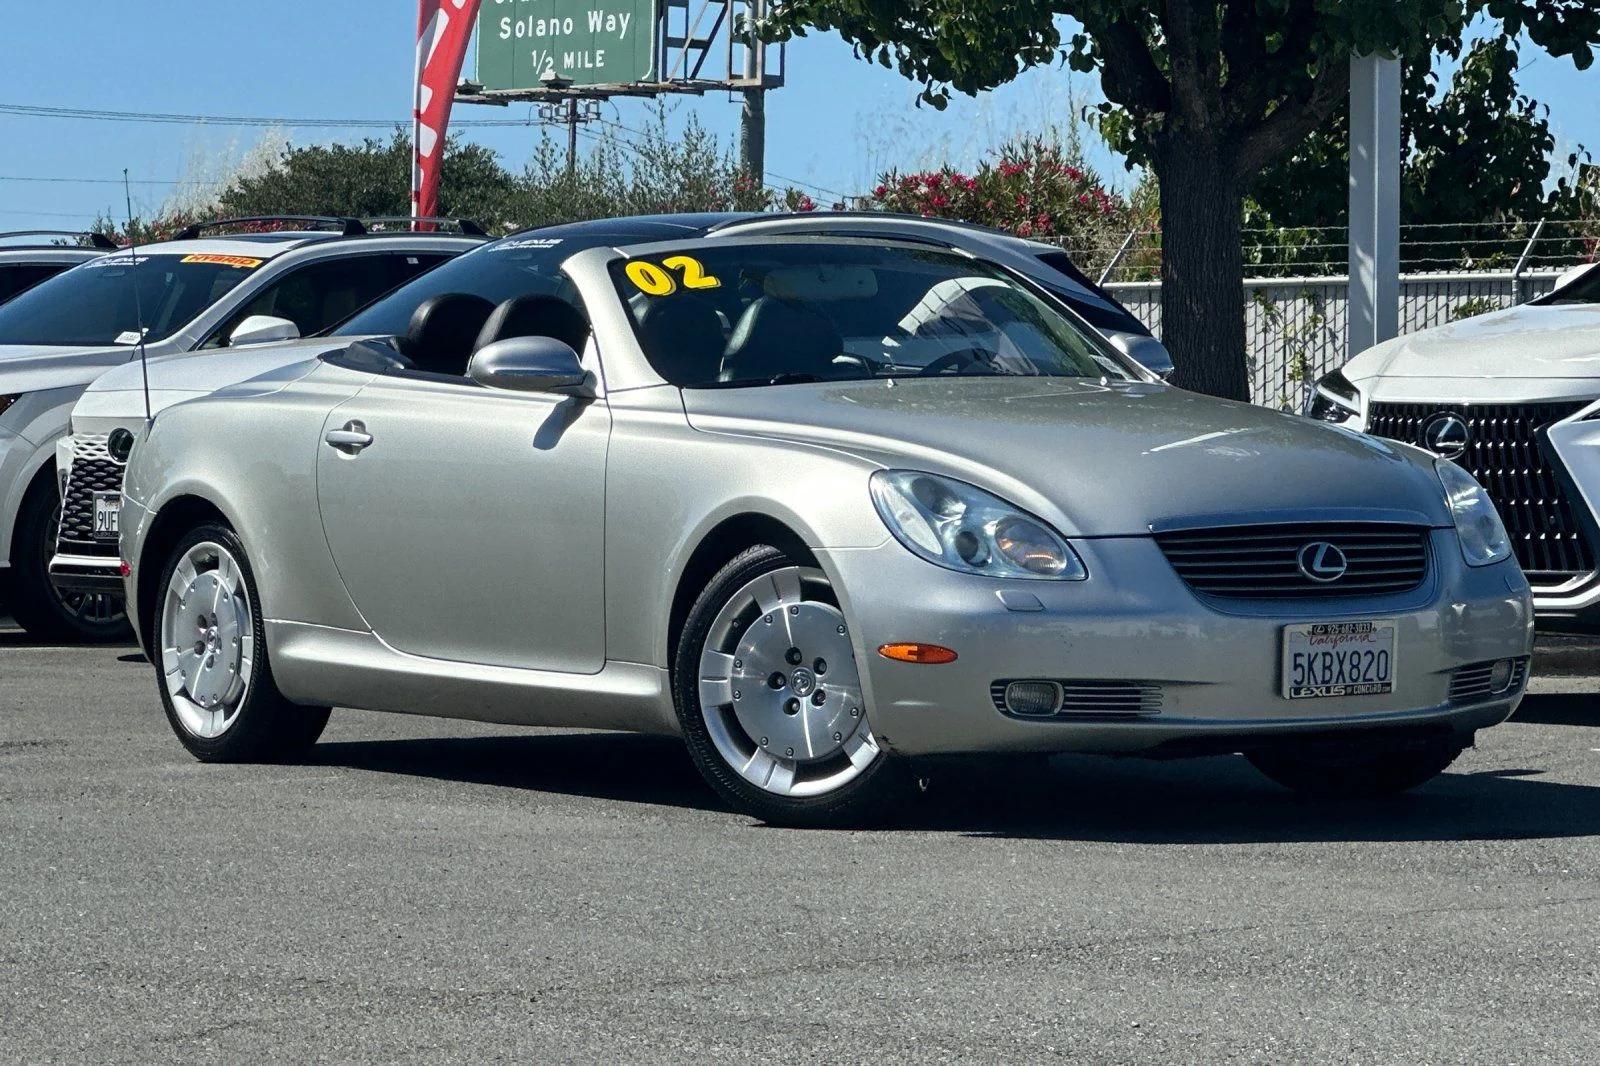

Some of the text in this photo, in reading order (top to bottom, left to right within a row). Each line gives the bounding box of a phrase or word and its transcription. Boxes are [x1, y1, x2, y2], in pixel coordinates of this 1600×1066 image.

[499, 10, 631, 39] Solano Way
[563, 49, 605, 70] MILE
[188, 254, 256, 266] HYBRID
[625, 256, 720, 296] 02
[97, 510, 120, 531] 9UF
[1309, 634, 1376, 649] California
[1293, 650, 1388, 685] 5KBX820
[1290, 685, 1346, 698] LEXUS
